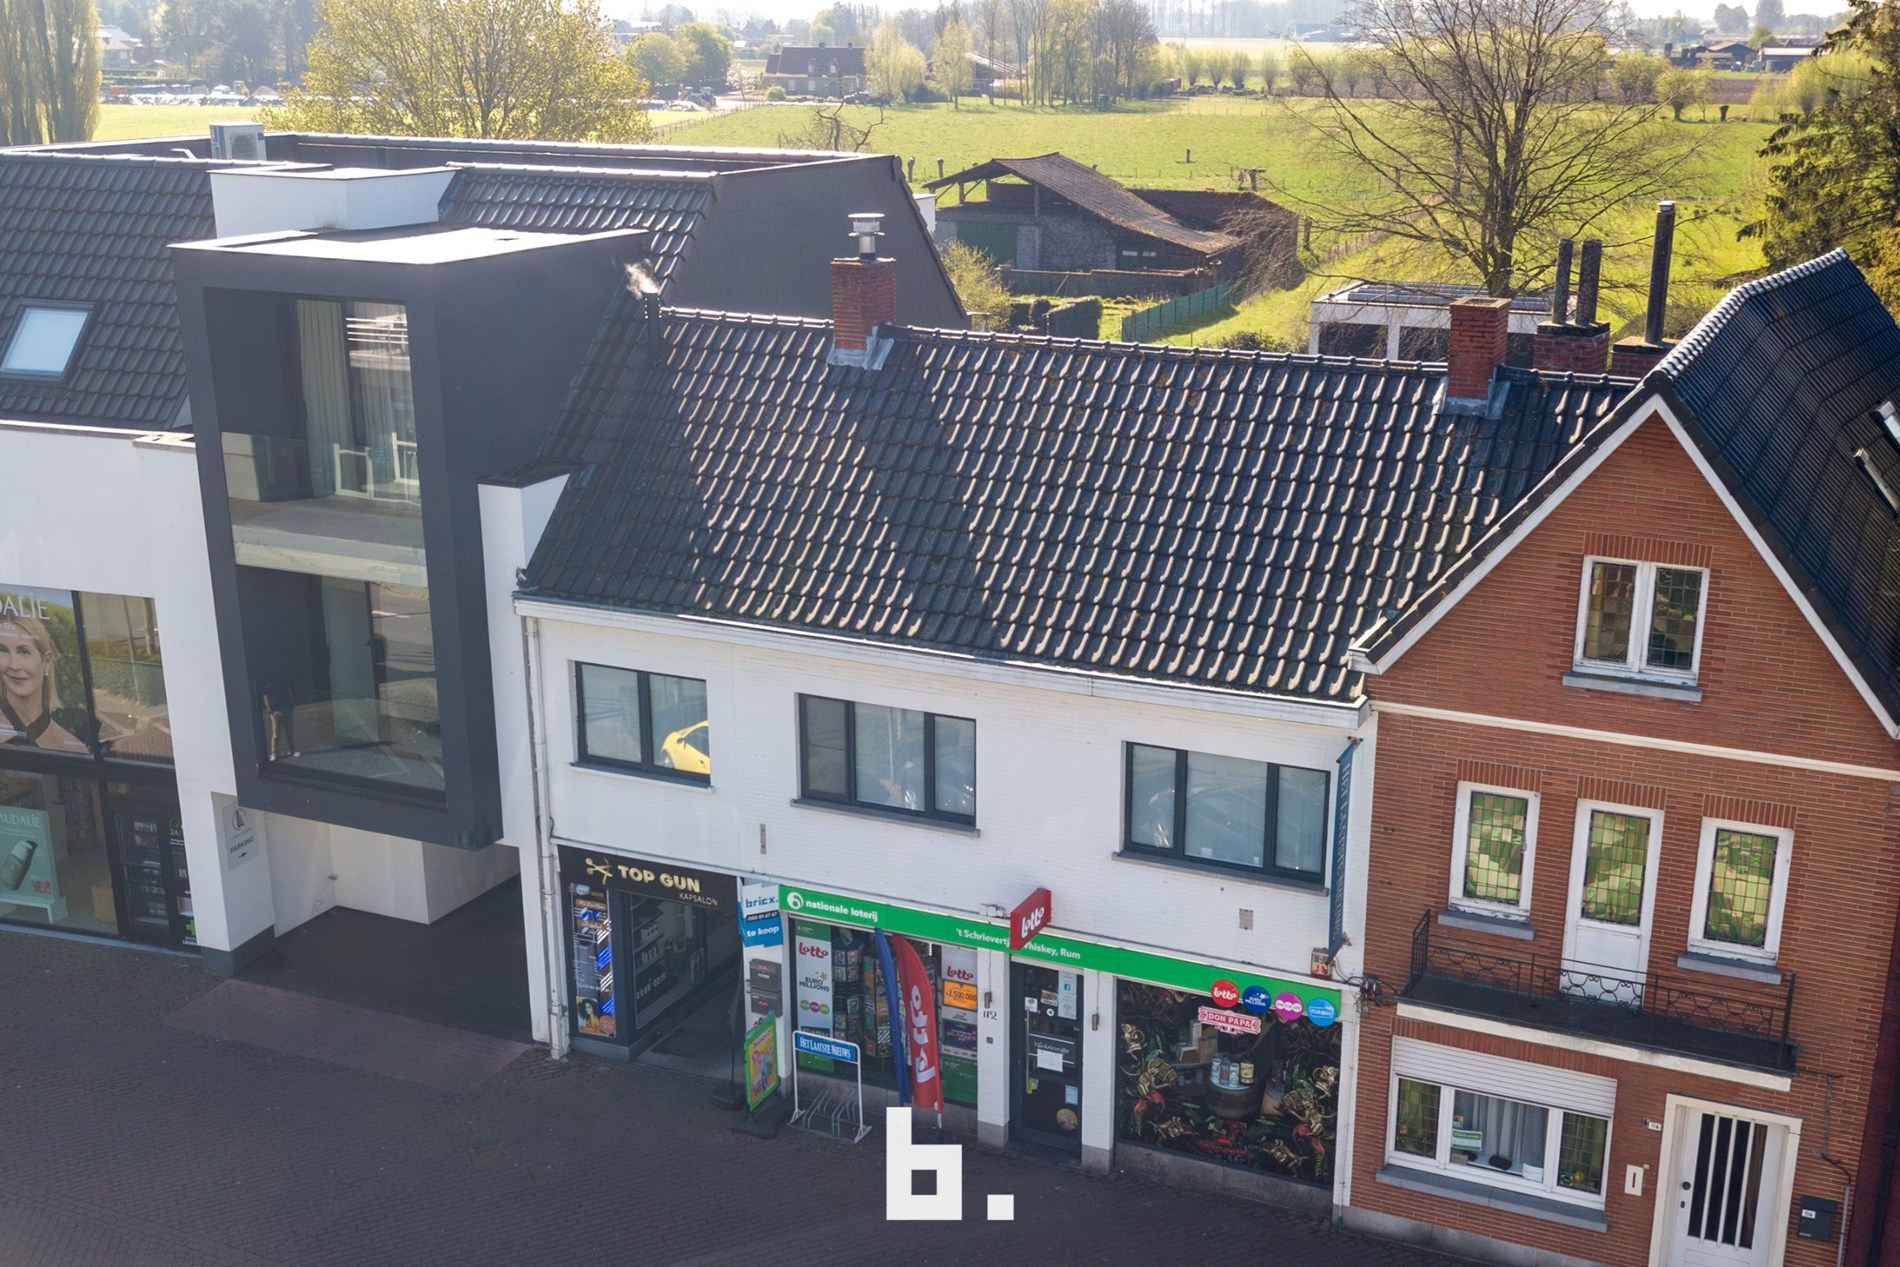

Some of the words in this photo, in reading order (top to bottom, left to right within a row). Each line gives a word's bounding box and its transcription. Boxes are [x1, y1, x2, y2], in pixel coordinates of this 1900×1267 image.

[229, 835, 255, 854] PARKING
[617, 865, 655, 883] TOP
[660, 873, 700, 893] GUN
[679, 892, 718, 906] KAPSALON
[805, 900, 849, 915] nationale
[851, 907, 878, 922] loterij
[1021, 907, 1045, 938] Lotto
[746, 929, 757, 937] te
[757, 926, 780, 935] koop
[798, 942, 829, 959] Lotto
[963, 928, 1010, 948] Schrievertj
[1060, 948, 1081, 960] Rum
[805, 976, 824, 986] EURO
[947, 966, 974, 980] Lotto
[799, 980, 830, 992] MILLIONS
[1213, 987, 1237, 1001] Lotto
[983, 1010, 998, 1021] 112
[1208, 1013, 1226, 1023] DON
[1228, 1016, 1251, 1028] PAPA
[912, 984, 935, 1083] Lotto
[800, 1036, 810, 1050] HET
[810, 1038, 831, 1055] LAATSTE
[831, 1044, 851, 1060] NIEUWS
